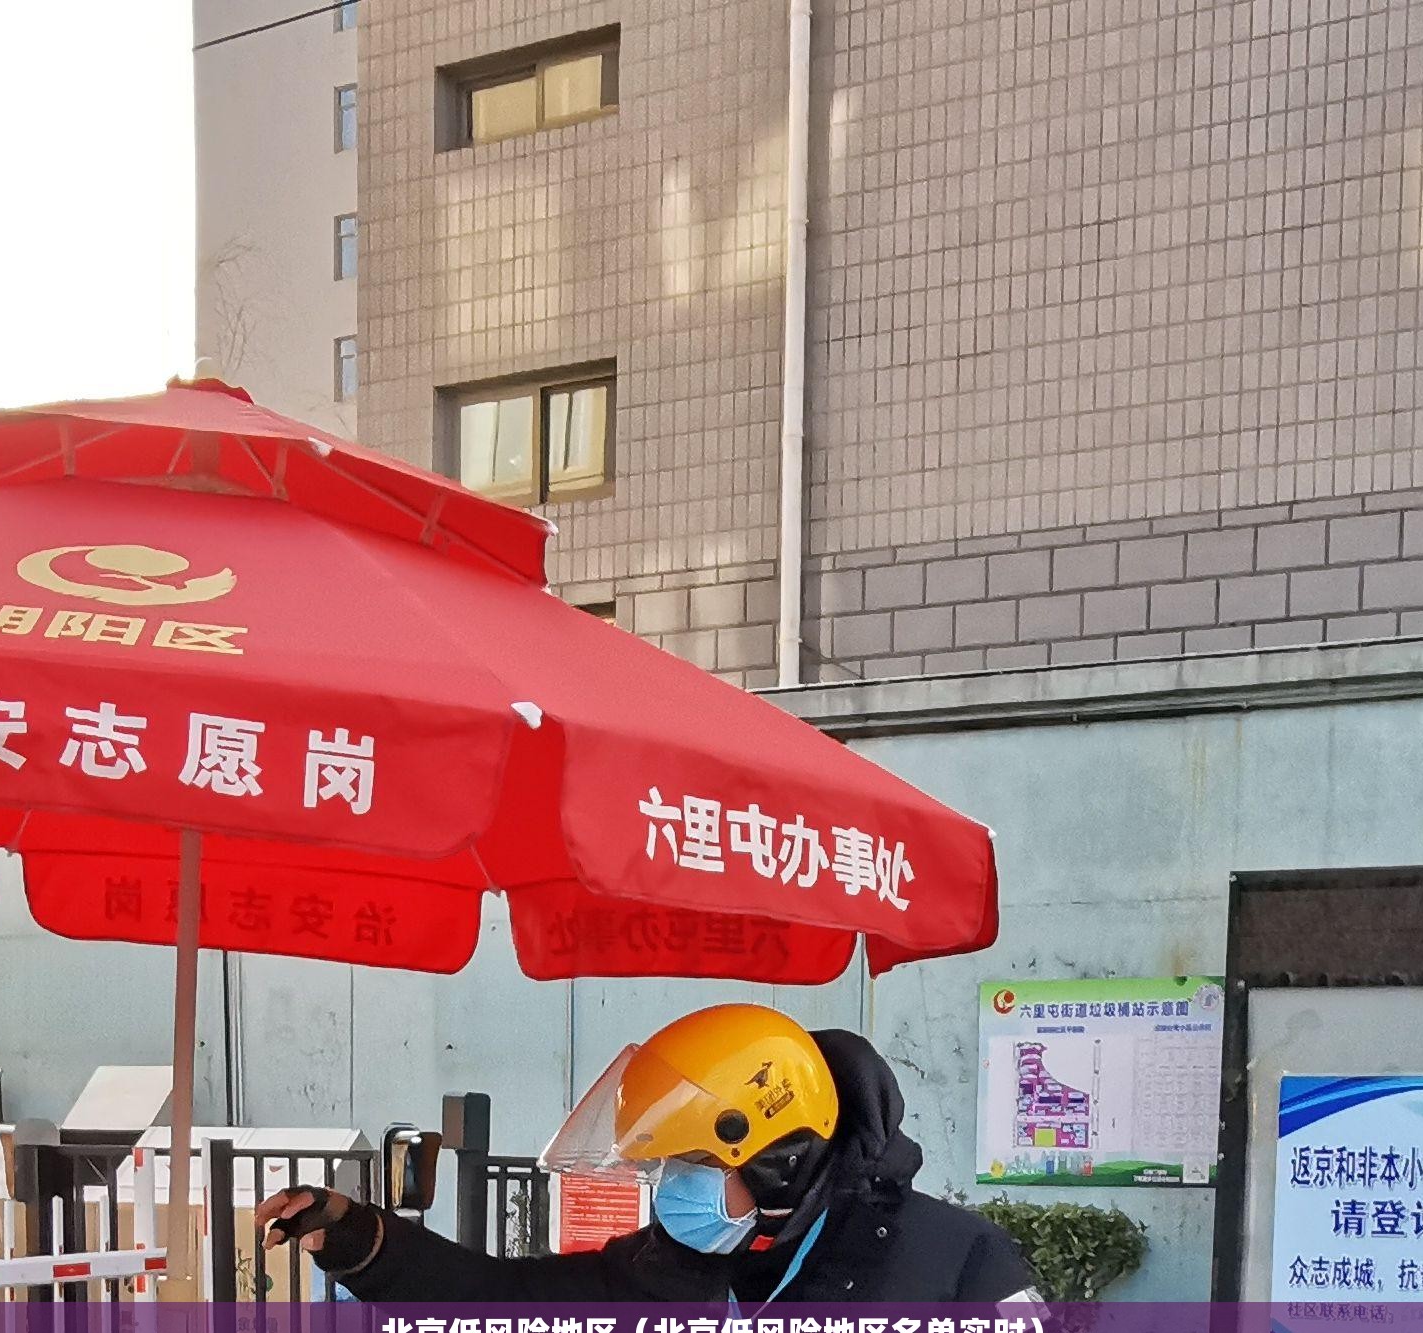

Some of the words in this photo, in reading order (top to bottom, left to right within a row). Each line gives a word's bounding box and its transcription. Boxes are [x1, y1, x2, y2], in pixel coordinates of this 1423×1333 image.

[638, 786, 916, 911] 六里屯办事处
